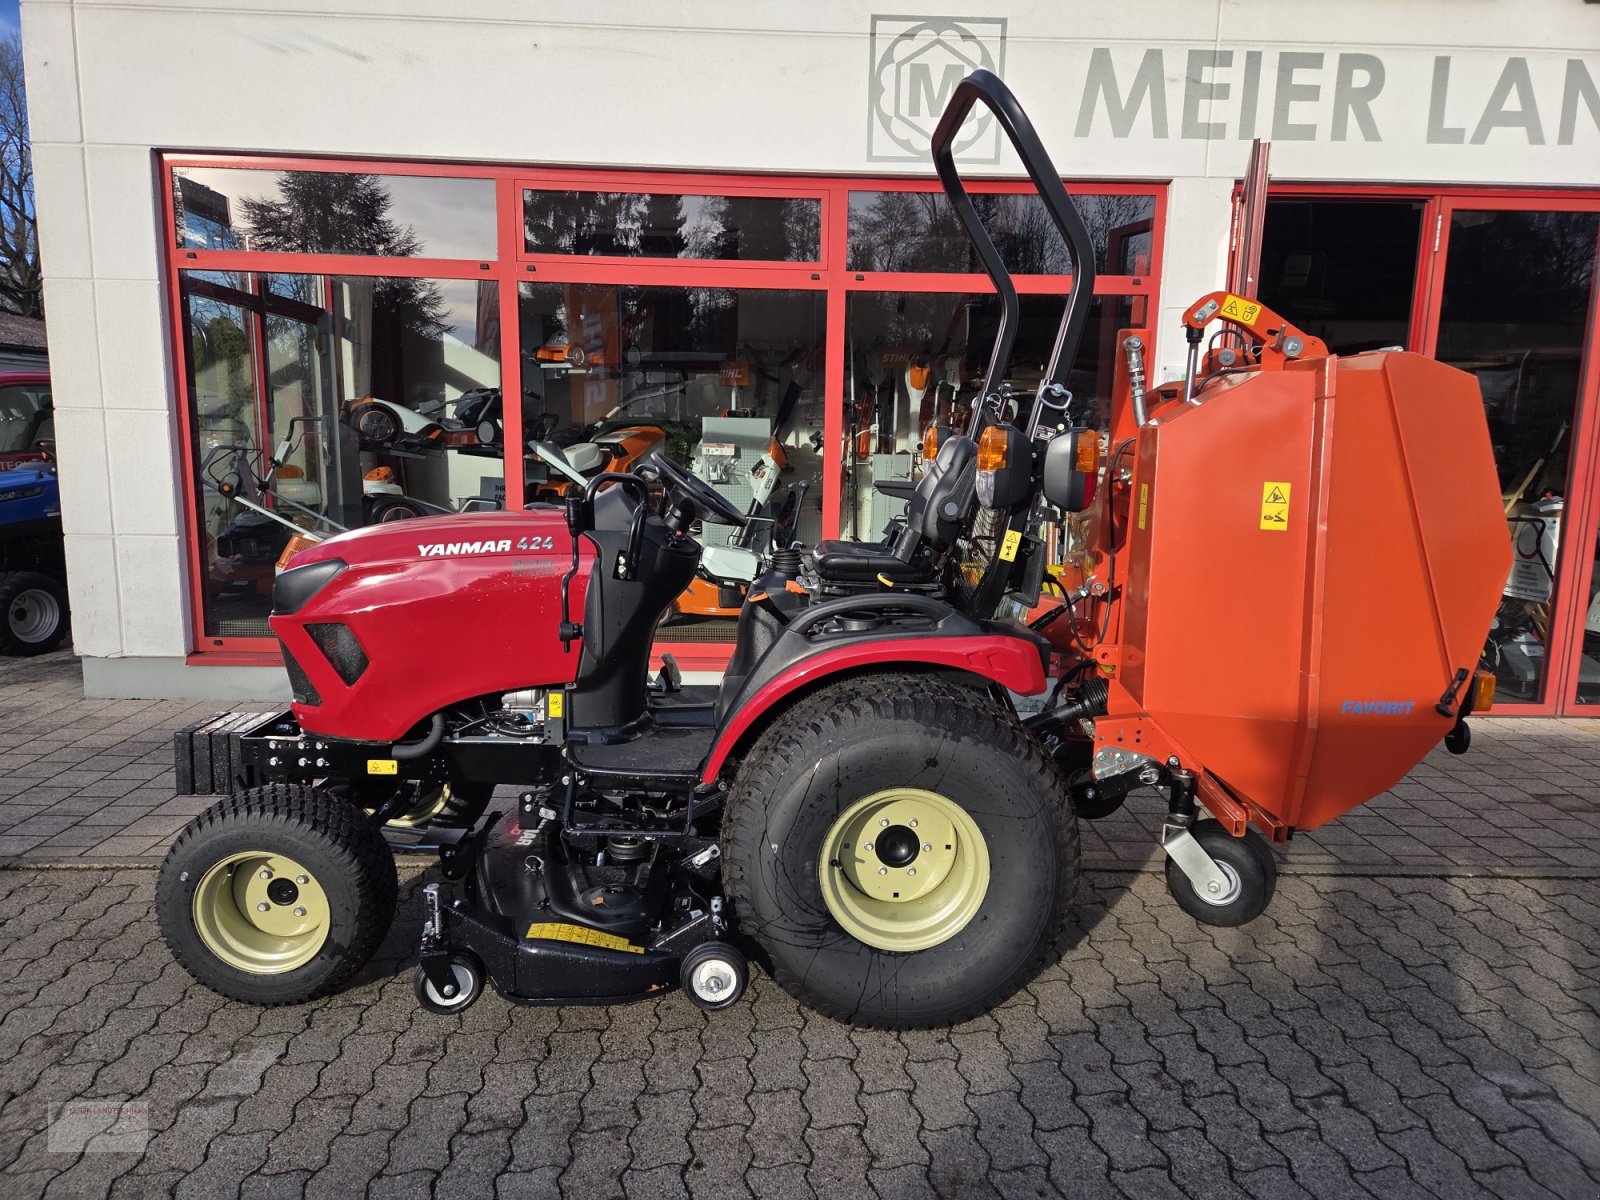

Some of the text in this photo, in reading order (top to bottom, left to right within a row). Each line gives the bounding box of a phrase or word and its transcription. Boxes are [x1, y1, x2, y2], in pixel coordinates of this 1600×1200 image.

[908, 63, 964, 118] M
[1075, 47, 1386, 142] MEIER
[719, 368, 742, 378] TIHL
[417, 536, 554, 557] YANMAR 424
[1341, 700, 1416, 715] FAVORIT
